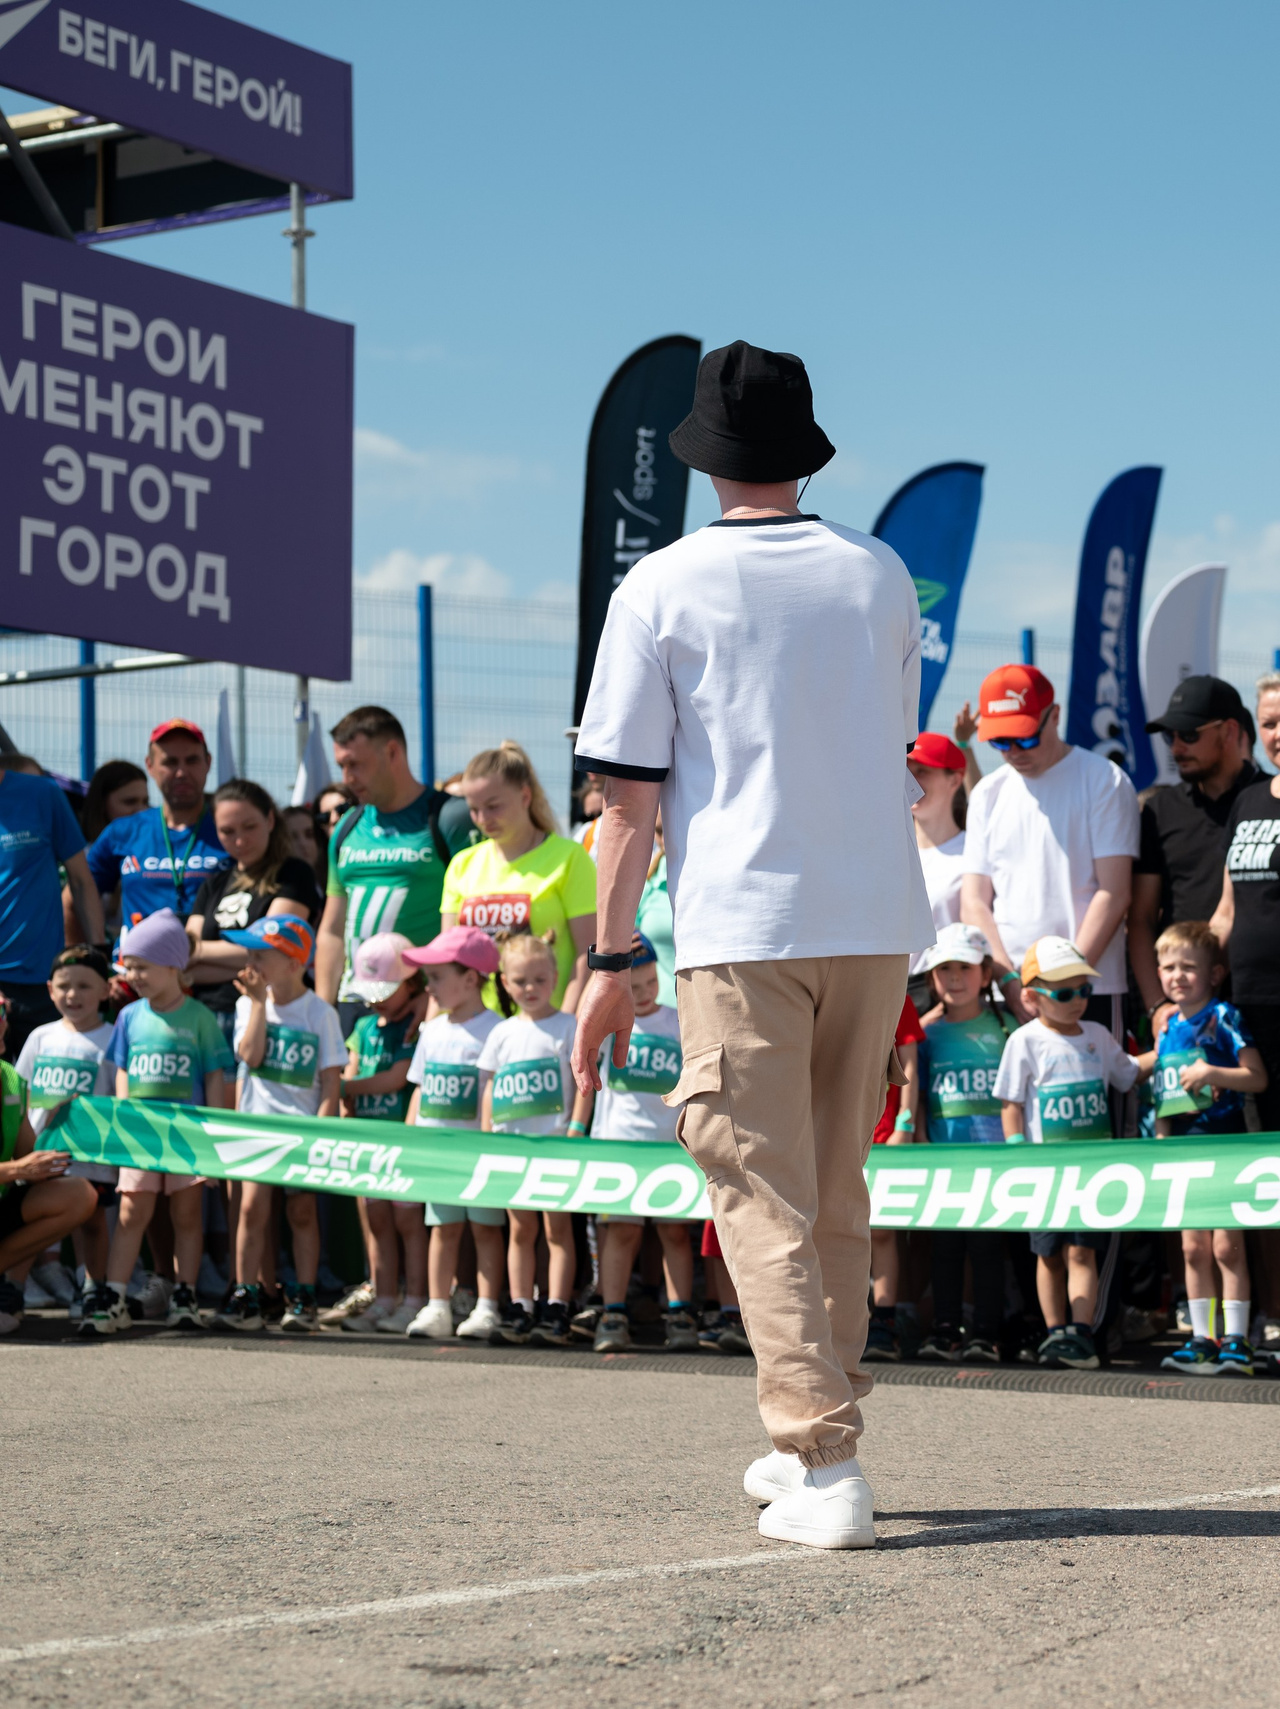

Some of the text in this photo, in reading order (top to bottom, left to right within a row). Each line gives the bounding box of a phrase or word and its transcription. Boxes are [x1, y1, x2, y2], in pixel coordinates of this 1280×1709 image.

[58, 9, 303, 137] БЕГИ, ГЕРОЙ!
[21, 281, 228, 391] ГЕРОИ
[632, 425, 659, 501] sport
[42, 445, 211, 531] ЭТОТ
[19, 515, 231, 623] ГОРОД
[462, 902, 528, 927] 10789
[128, 1052, 192, 1078] 40052
[625, 1044, 679, 1075] 0184
[33, 1066, 93, 1093] 40002
[494, 1068, 559, 1100] 40030
[932, 1068, 1000, 1095] 40185
[1043, 1092, 1107, 1122] 40136
[307, 1137, 403, 1175] БЕГИ,
[458, 1153, 713, 1220] ГЕРО
[863, 1160, 1216, 1229] ЕНЯЮТ
